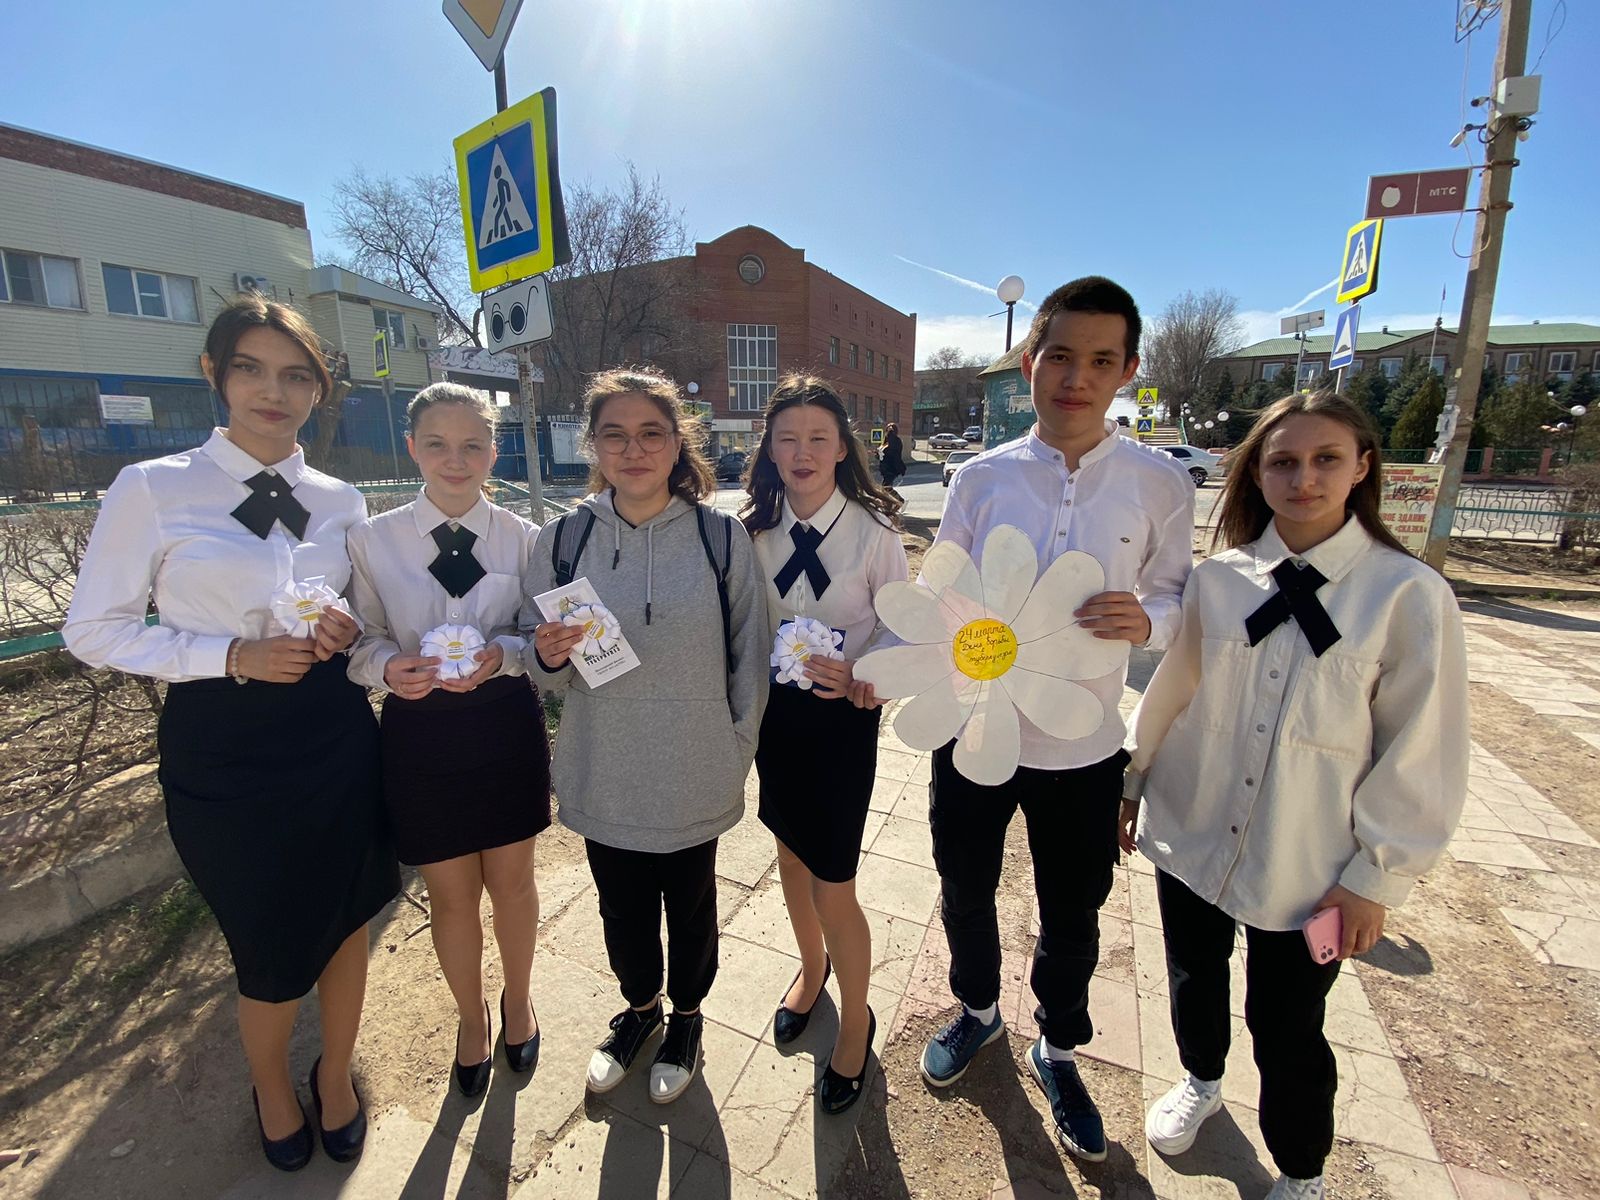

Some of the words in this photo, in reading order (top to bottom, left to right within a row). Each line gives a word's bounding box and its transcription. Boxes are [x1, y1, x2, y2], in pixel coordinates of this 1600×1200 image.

[1429, 186, 1457, 197] МТС
[958, 628, 973, 643] 24
[974, 626, 1006, 639] марта
[962, 642, 983, 651] День
